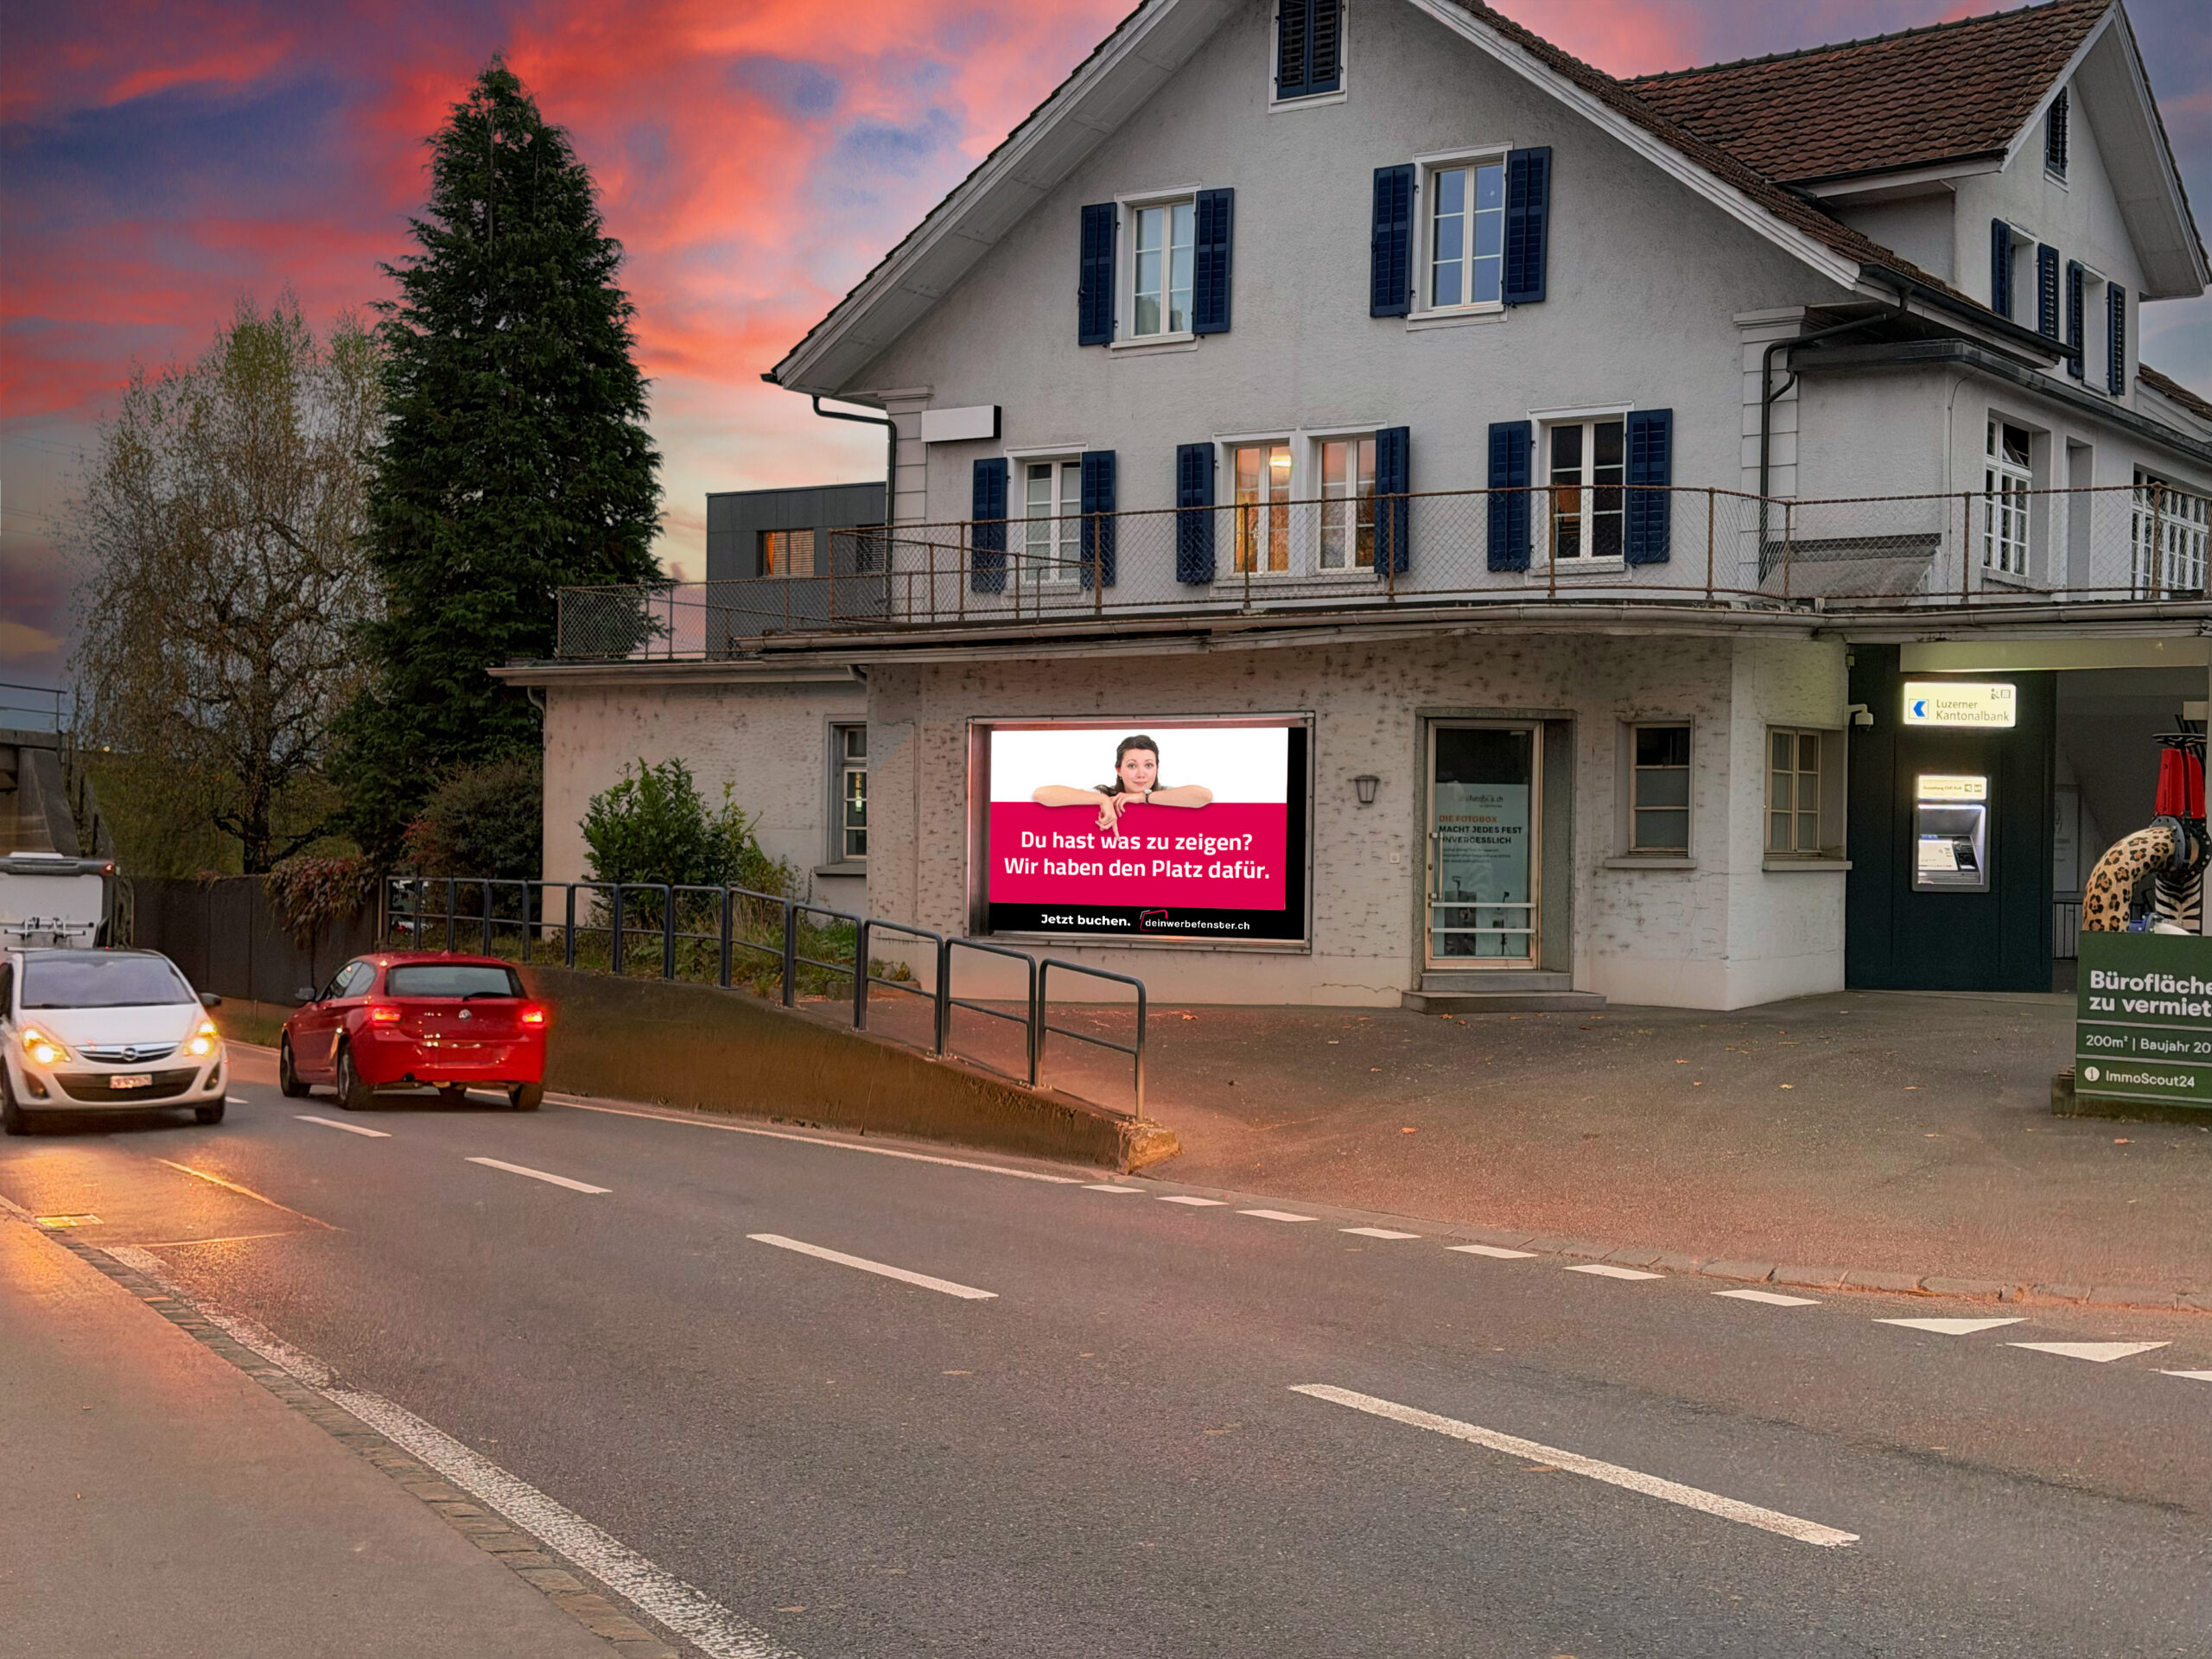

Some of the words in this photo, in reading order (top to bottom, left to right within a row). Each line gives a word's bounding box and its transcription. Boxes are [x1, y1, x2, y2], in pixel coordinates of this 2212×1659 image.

[1936, 699, 1978, 709] Luzerner
[1936, 710, 2009, 721] Kantonalbank
[1456, 815, 1498, 823] FOTOBOX
[1020, 830, 1046, 848] Du
[1052, 832, 1095, 849] hast
[1101, 835, 1141, 849] was
[1147, 836, 1169, 849] zu
[1175, 833, 1253, 855] zeigen?
[1004, 857, 1039, 874] Wir
[1044, 858, 1103, 876] haben
[1109, 860, 1146, 877] den
[1153, 861, 1203, 878] Platz
[1208, 861, 1269, 879] dafür.
[1040, 914, 1074, 925] Jetzt
[1077, 914, 1131, 927] buchen.
[1145, 918, 1249, 930] deinwerbefenster.ch
[2089, 996, 2115, 1011] zu
[2121, 996, 2212, 1018] vermiet
[2140, 1038, 2190, 1053] Baujahr
[2193, 1041, 2212, 1054] 20
[2105, 1070, 2196, 1088] ImmoScout24
